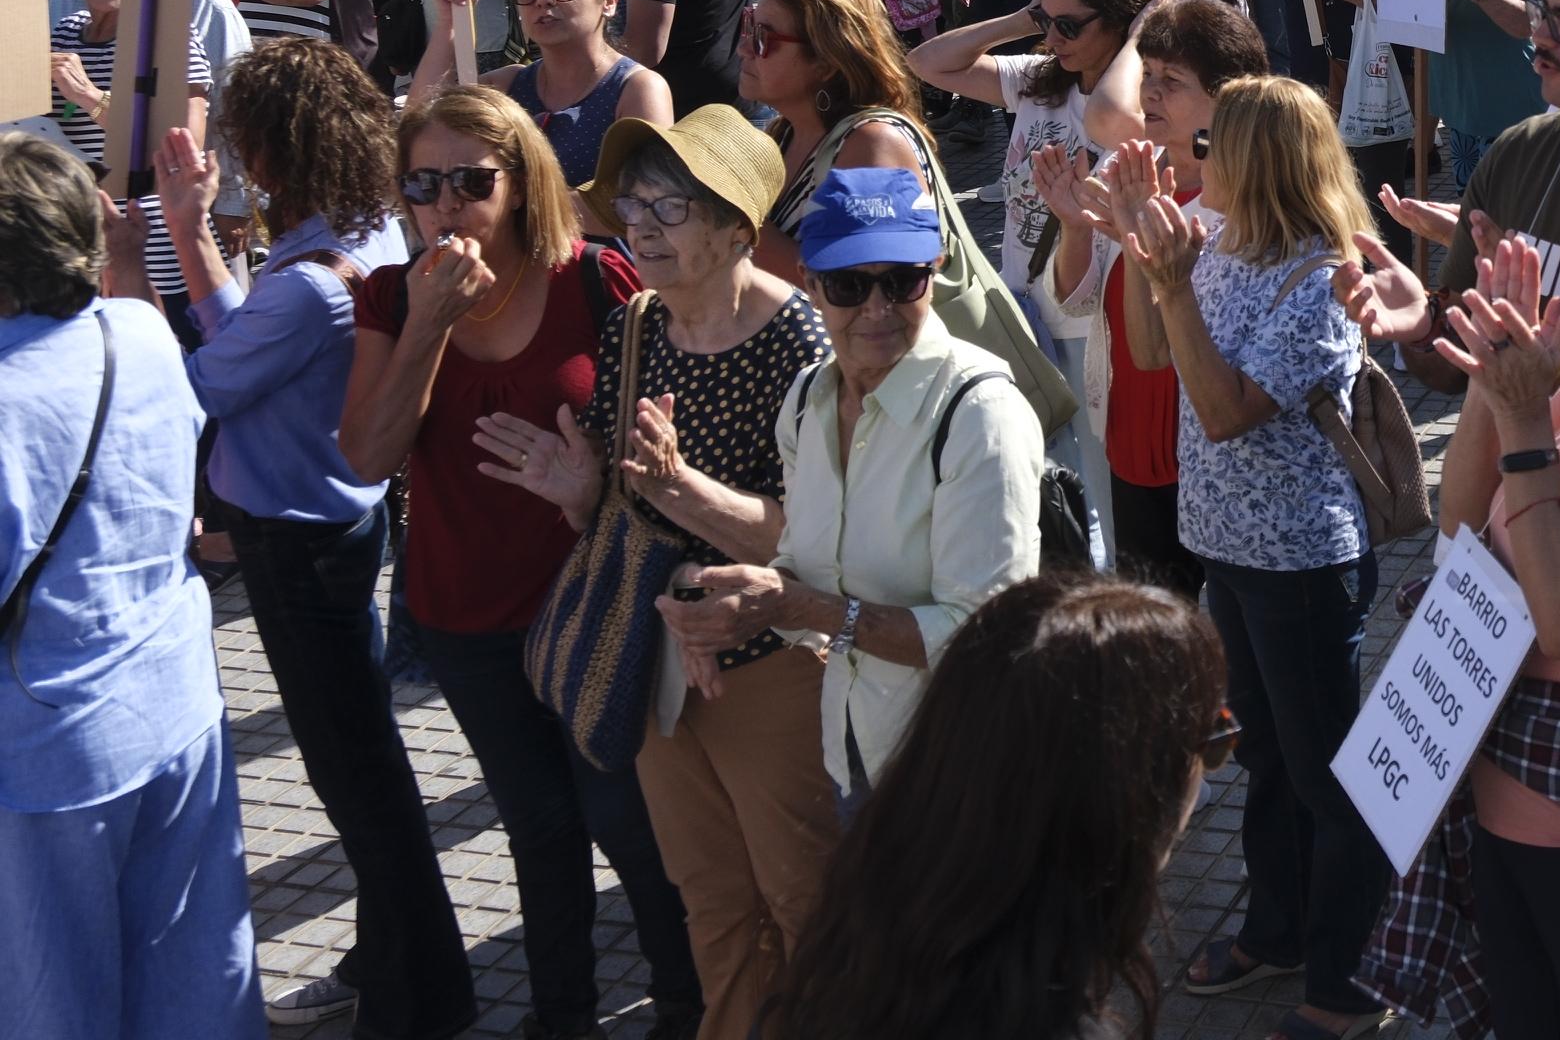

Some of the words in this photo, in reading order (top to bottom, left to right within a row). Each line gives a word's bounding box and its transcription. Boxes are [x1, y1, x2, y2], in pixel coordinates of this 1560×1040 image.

[1456, 572, 1507, 640] BARRIO
[1423, 599, 1451, 639] LAS
[1447, 627, 1498, 699] TORRES
[1412, 653, 1464, 727] UNIDOS
[1380, 681, 1425, 745] SOMOS
[1419, 735, 1451, 781] MÁS
[1367, 736, 1409, 802] LPGC
